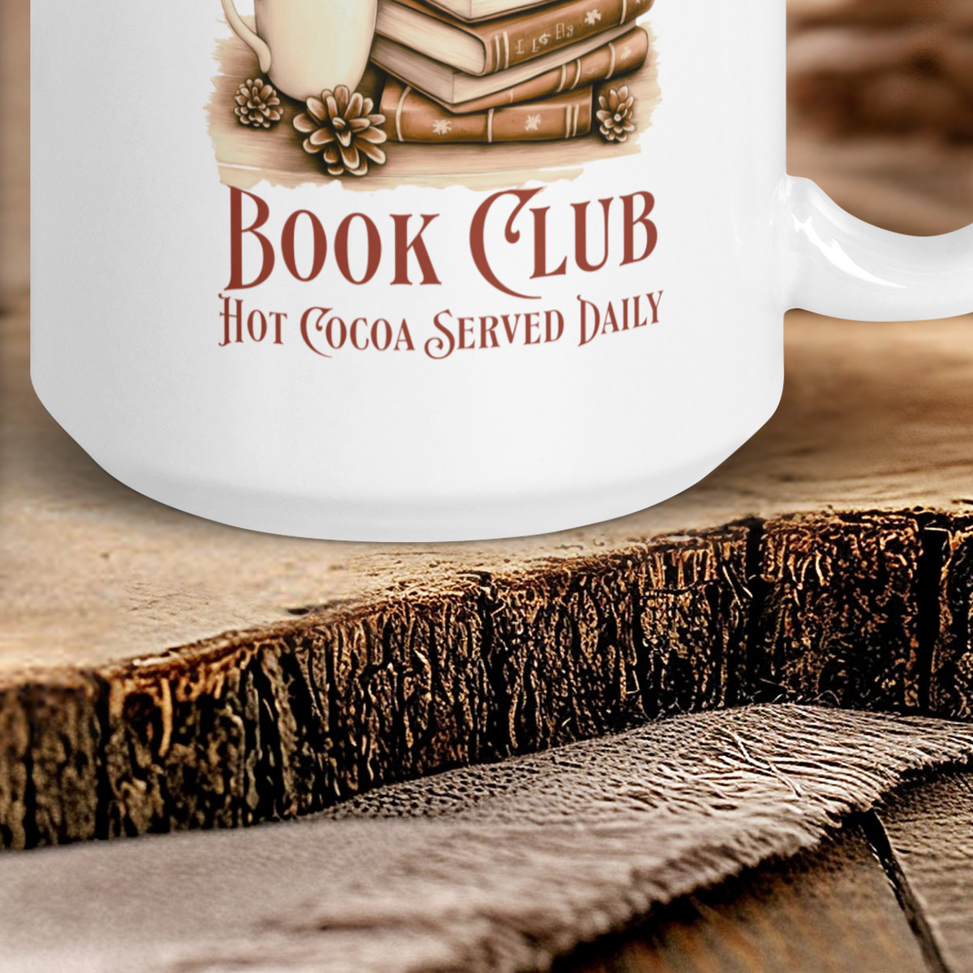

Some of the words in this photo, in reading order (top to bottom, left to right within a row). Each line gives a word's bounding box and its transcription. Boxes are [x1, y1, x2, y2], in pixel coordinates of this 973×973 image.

[223, 185, 443, 291] BOOK
[470, 187, 659, 300] CLUB
[217, 292, 287, 347] HOT
[300, 306, 417, 359] COCOA
[423, 308, 566, 361] SERVED
[576, 290, 665, 348] DAILY
